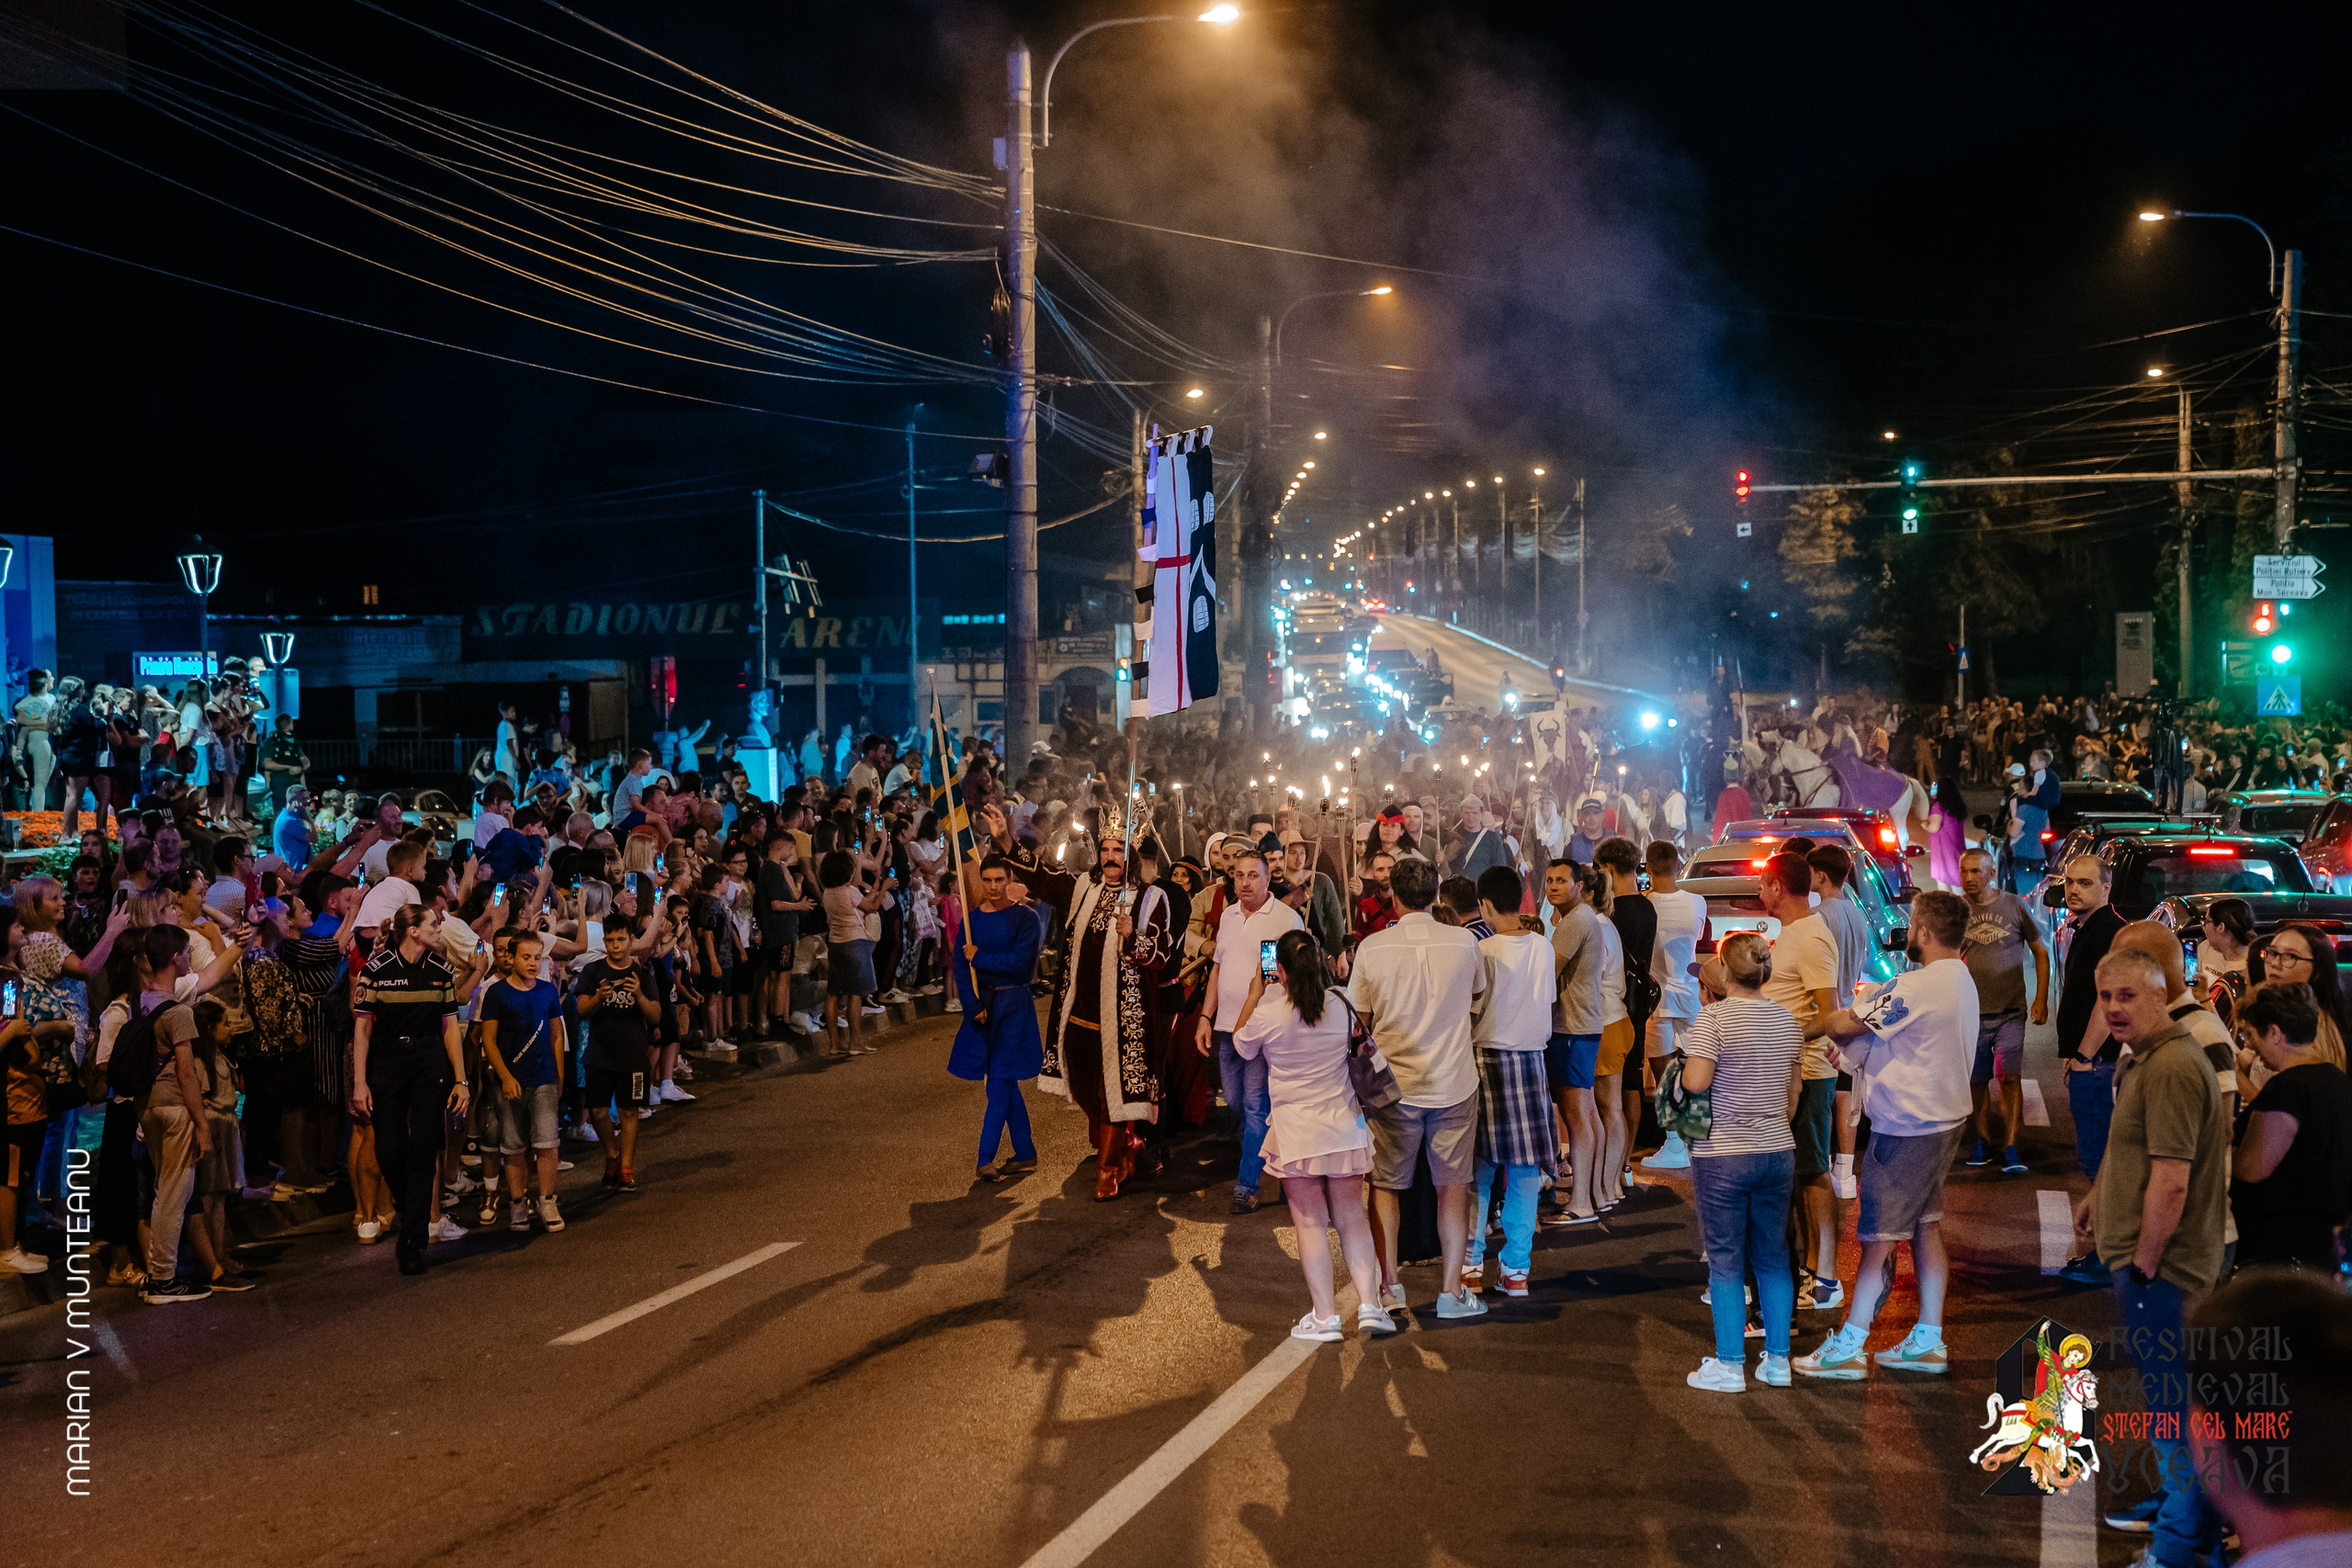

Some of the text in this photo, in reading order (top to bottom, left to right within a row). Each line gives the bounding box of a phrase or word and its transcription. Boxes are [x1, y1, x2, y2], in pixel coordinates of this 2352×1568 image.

[2284, 568, 2312, 577] Rutiere
[2277, 589, 2309, 597] Suceava
[470, 602, 741, 638] STADIONUL
